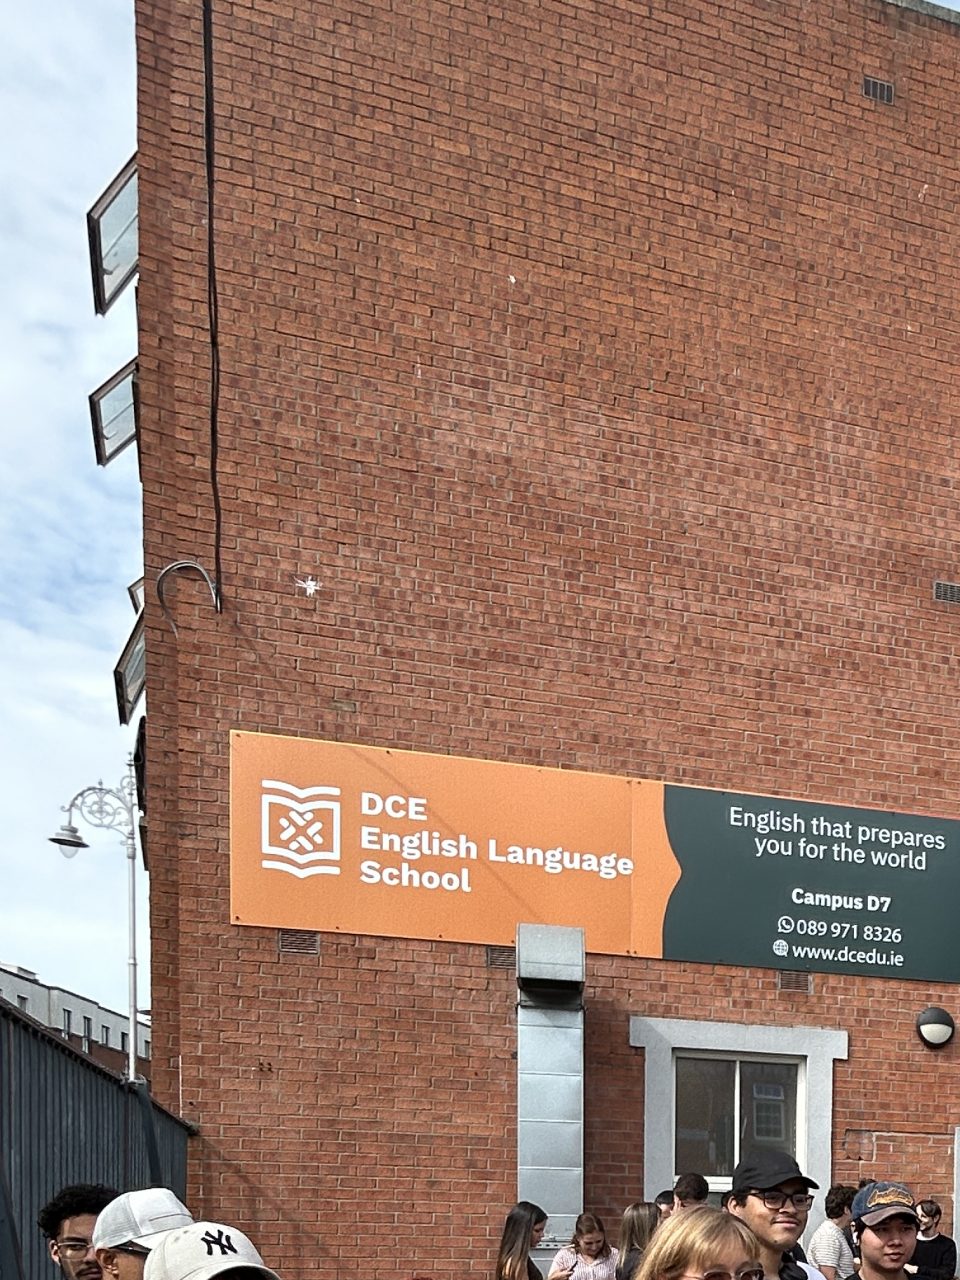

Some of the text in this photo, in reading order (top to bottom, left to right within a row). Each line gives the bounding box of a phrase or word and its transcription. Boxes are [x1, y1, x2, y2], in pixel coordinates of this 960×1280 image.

[360, 791, 428, 821] DCE
[729, 806, 946, 850] English that prepares
[360, 825, 634, 880] English Language
[754, 837, 926, 871] you for the world
[359, 860, 472, 893] School
[791, 887, 892, 912] Campus D7
[796, 919, 902, 943] 089 971 8326
[792, 945, 904, 967] www.dcedu.ie
